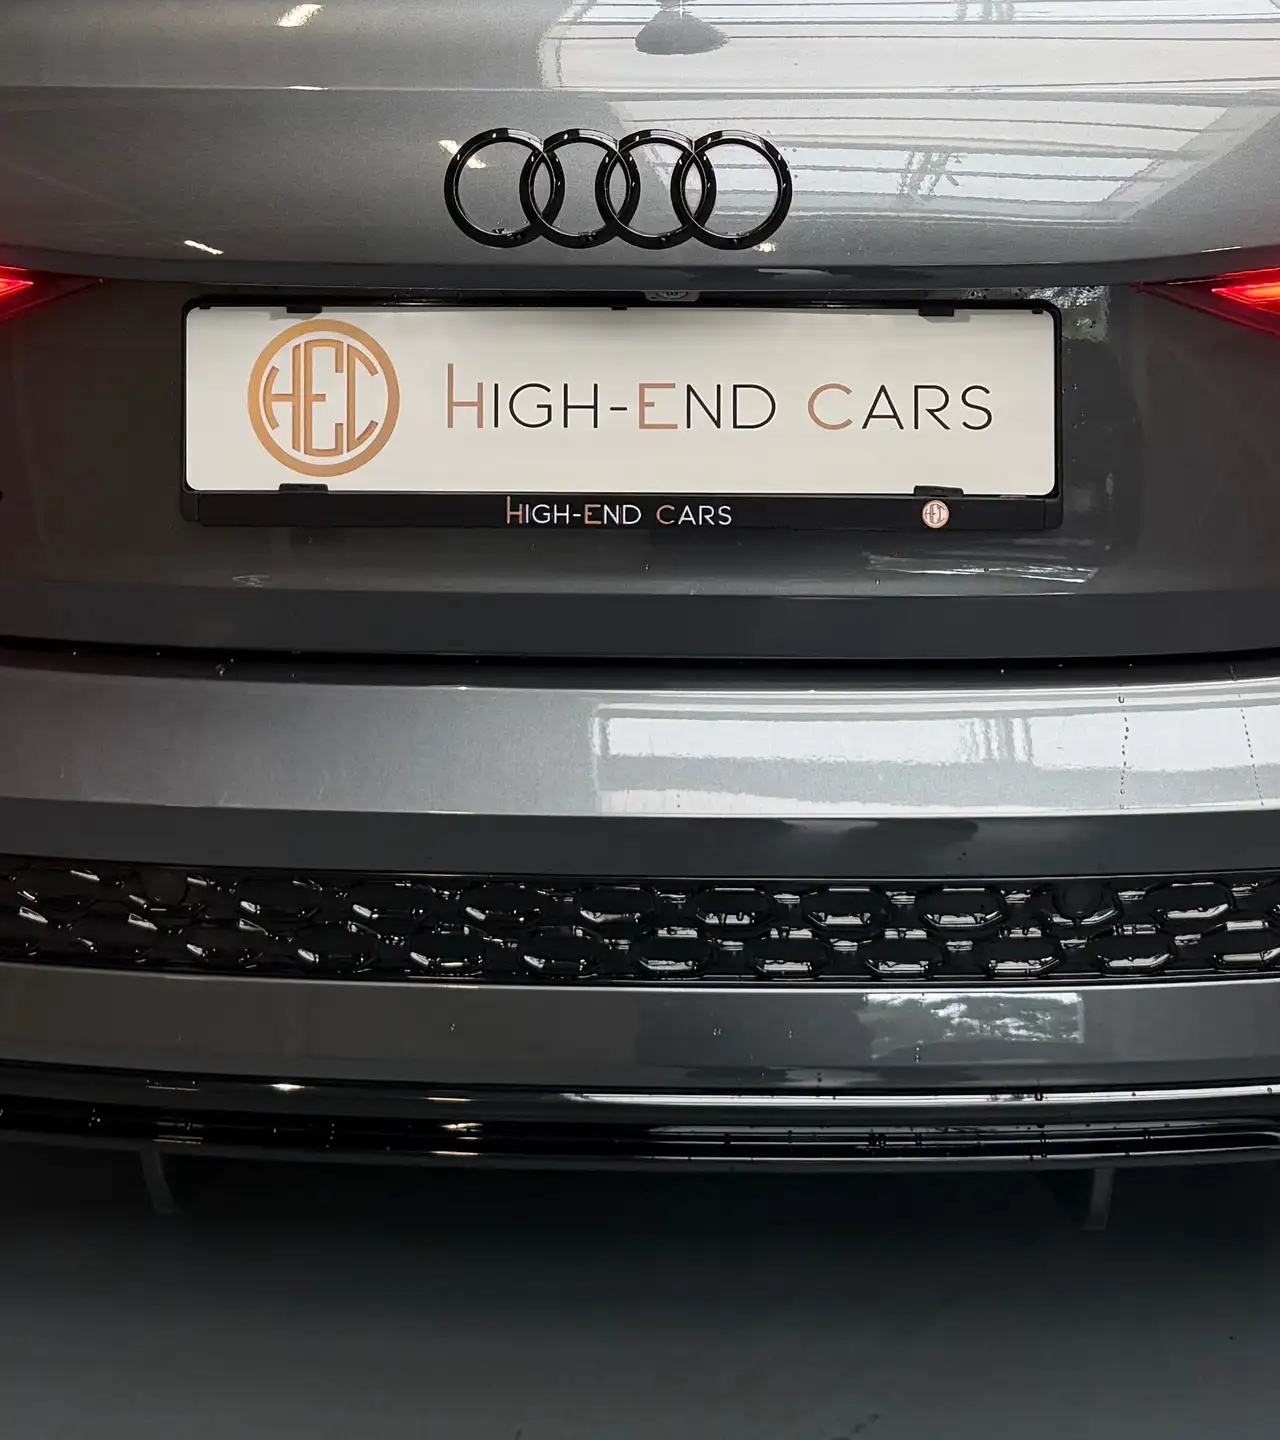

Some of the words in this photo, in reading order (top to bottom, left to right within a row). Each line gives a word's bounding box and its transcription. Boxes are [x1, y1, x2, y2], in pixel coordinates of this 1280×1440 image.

[447, 362, 777, 430] HIGH-END
[807, 382, 994, 431] CARS
[506, 495, 642, 526] HIGH-END
[655, 504, 733, 526] CARS
